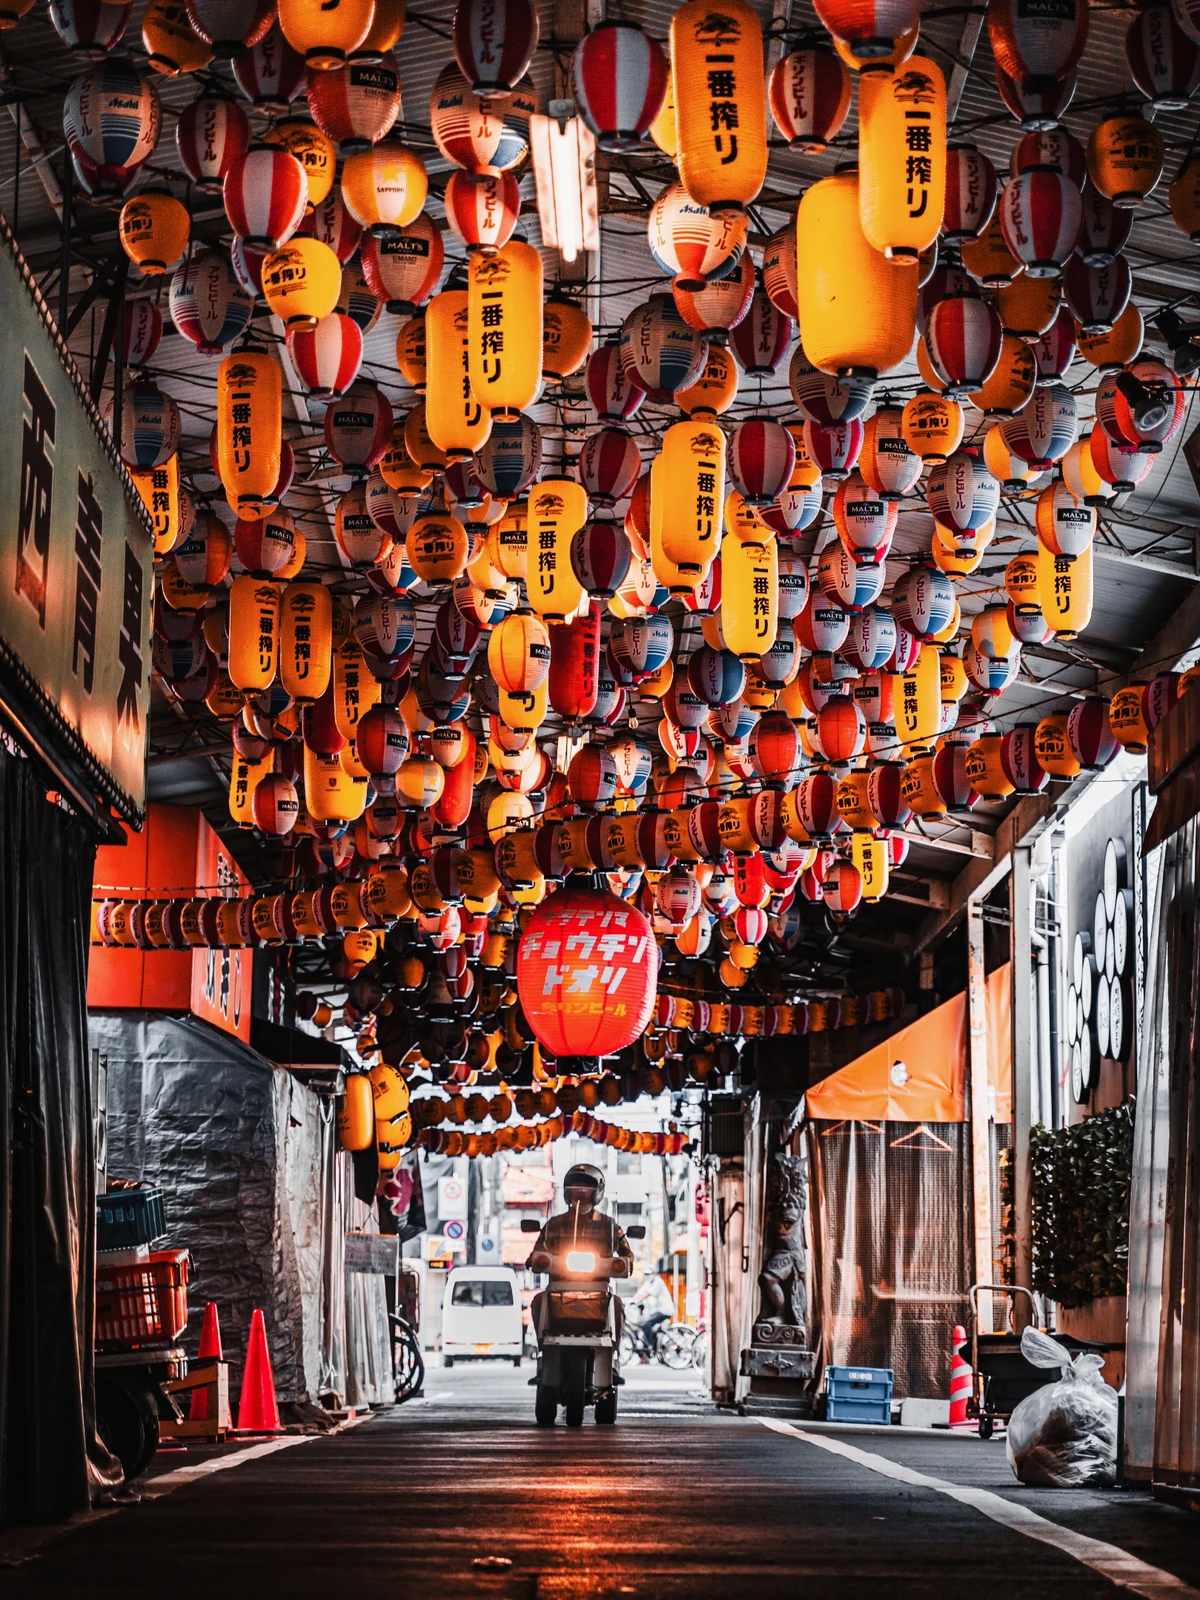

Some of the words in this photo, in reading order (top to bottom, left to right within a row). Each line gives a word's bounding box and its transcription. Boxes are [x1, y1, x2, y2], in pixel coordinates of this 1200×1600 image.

[359, 73, 395, 86] MALT'S
[792, 56, 807, 119] キリンビール
[108, 98, 139, 110] Asahi
[706, 55, 739, 164] 一番搾り
[904, 111, 932, 218] 一番搾り
[387, 241, 423, 251] MALT'S
[207, 266, 219, 320] アサヒビール
[265, 268, 306, 284] 一番搾り
[480, 291, 505, 382] 一番搾り
[668, 333, 694, 343] Asahi
[138, 414, 161, 425] Asahi
[232, 392, 251, 472] 一番搾り
[338, 415, 368, 424] MALT'S
[909, 418, 948, 429] 一番搾り
[498, 441, 521, 450] Asahi
[696, 461, 716, 541] 一番搾り
[955, 463, 965, 509] アサヒビール
[415, 542, 454, 552] 一番搾り
[539, 521, 557, 594] 一番搾り
[916, 575, 925, 615] アサヒビール
[1007, 575, 1036, 584] 一番搾り
[752, 567, 770, 637] 一番搾り
[259, 609, 274, 672] 一番搾り
[295, 616, 311, 679] 一番搾り
[862, 613, 870, 653] アサヒビール
[344, 664, 359, 724] 一番搾り
[1110, 708, 1139, 719] 一番搾り
[1015, 734, 1025, 778] キリンビール
[761, 796, 769, 837] キリンビール
[862, 843, 873, 885] 一番搾り
[521, 932, 648, 963] チョウチン
[542, 965, 628, 995] ドオリ
